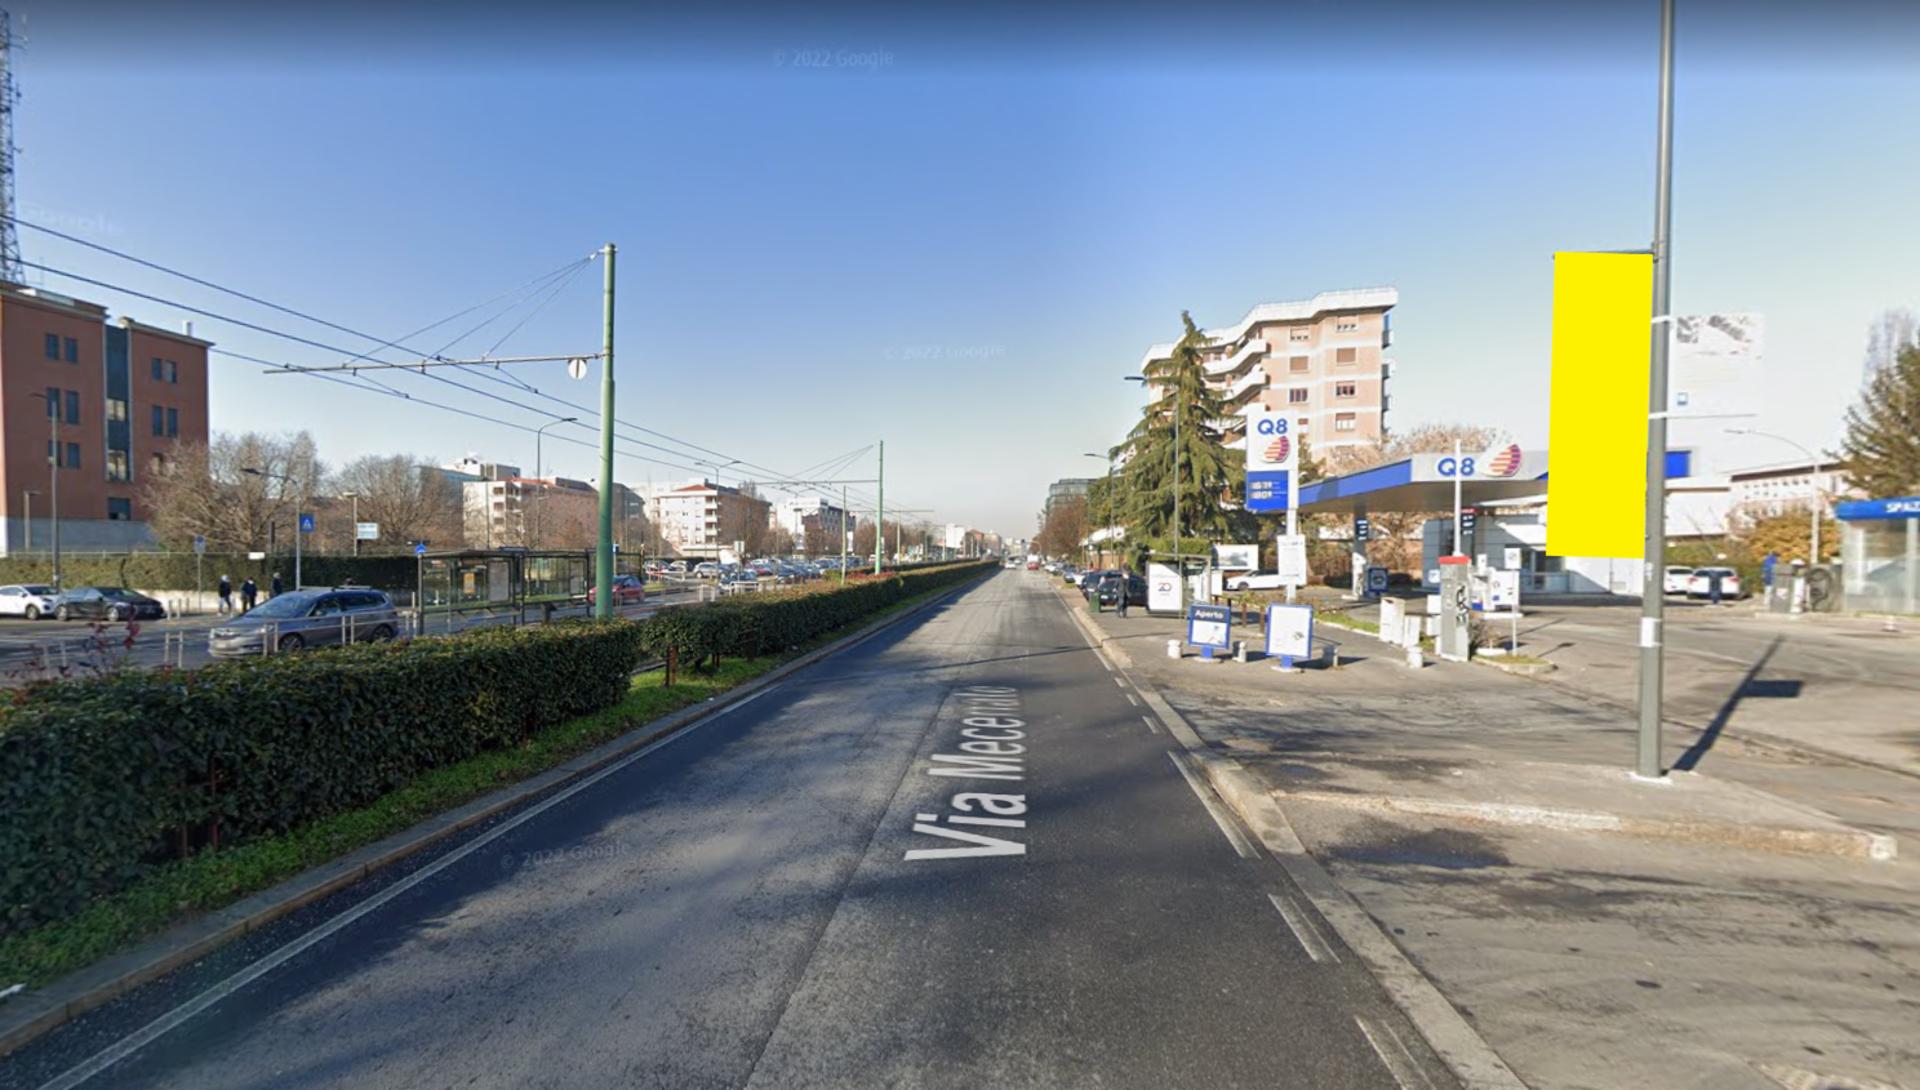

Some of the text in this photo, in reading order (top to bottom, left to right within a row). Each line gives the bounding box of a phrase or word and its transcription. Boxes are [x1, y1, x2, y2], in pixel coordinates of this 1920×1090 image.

[1257, 418, 1288, 435] Q8
[1438, 457, 1475, 476] Q8
[1194, 608, 1225, 620] Aperto
